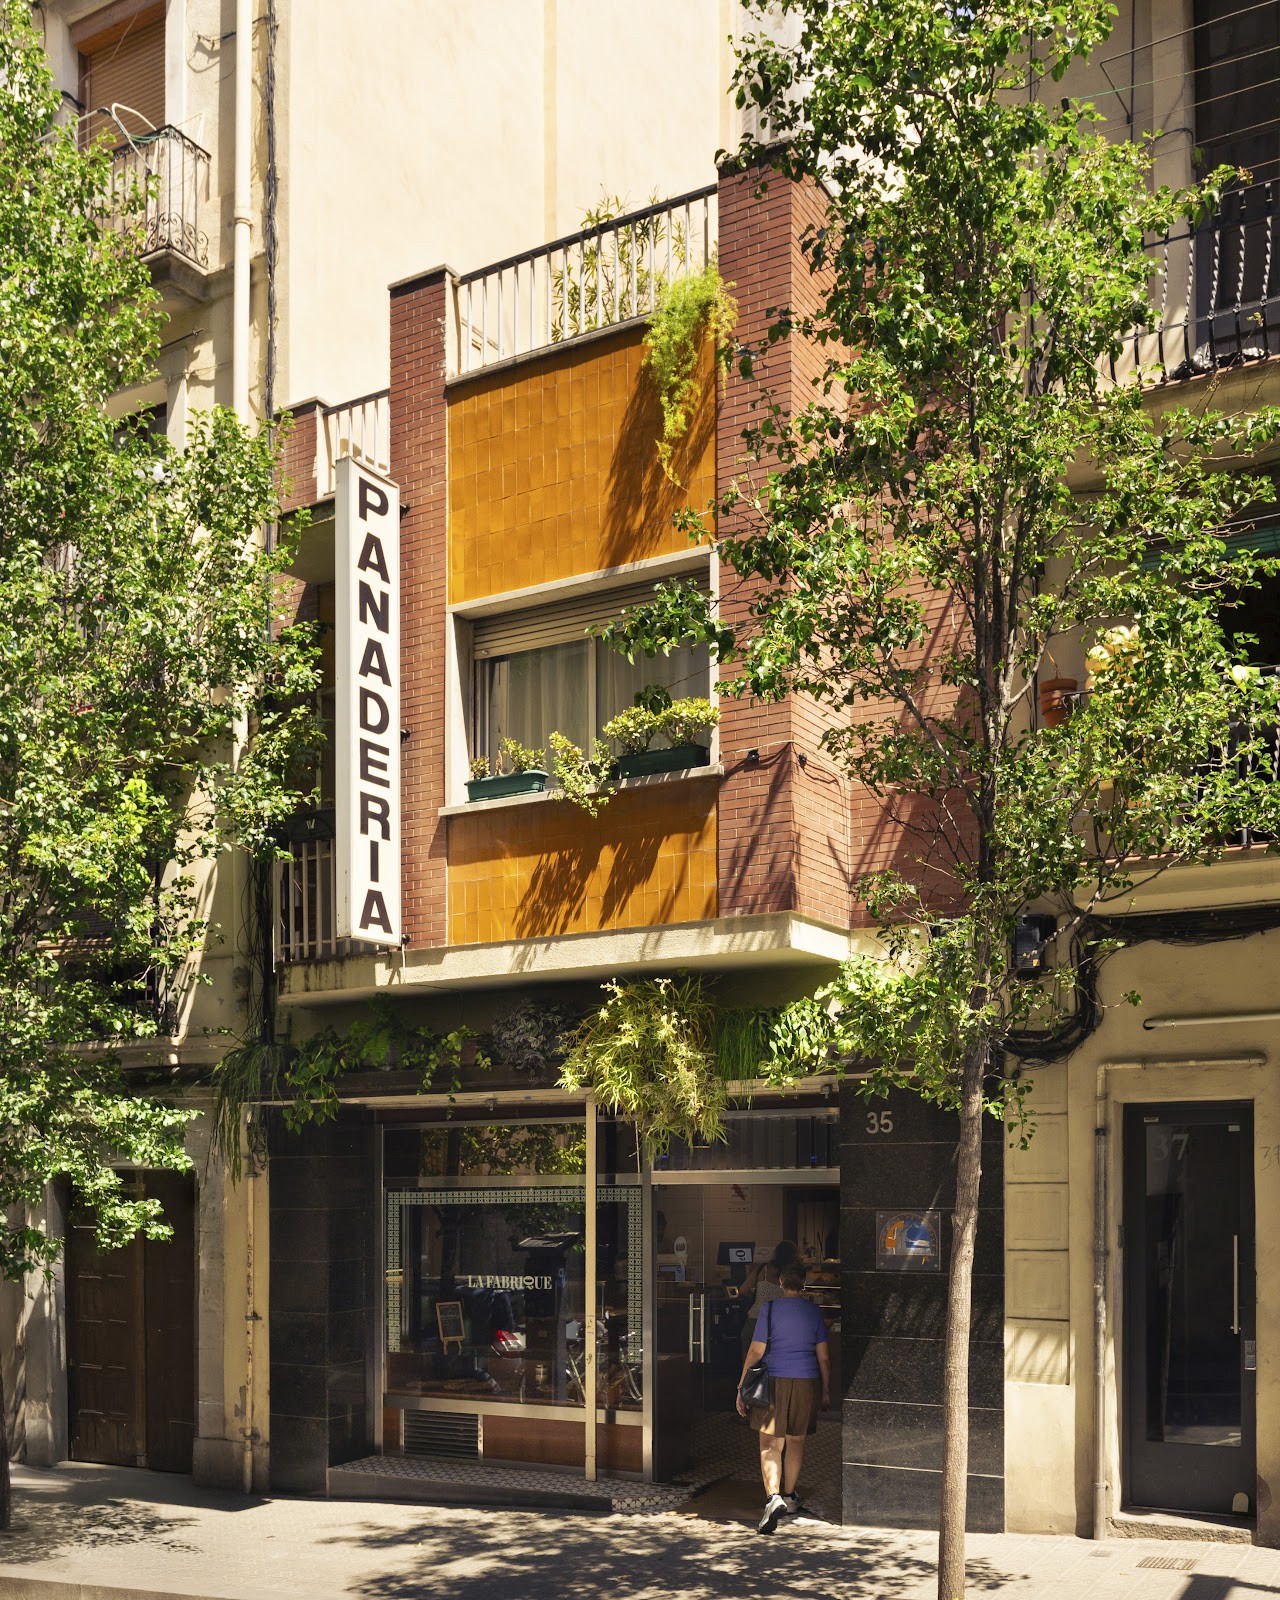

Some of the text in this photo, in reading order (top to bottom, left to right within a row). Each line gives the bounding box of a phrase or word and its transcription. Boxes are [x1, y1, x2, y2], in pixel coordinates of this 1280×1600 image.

[357, 476, 393, 935] PANADERIA
[865, 1110, 894, 1134] 35
[1152, 1133, 1189, 1161] 37
[467, 1274, 484, 1288] LA
[486, 1275, 553, 1290] FABRIQUE
